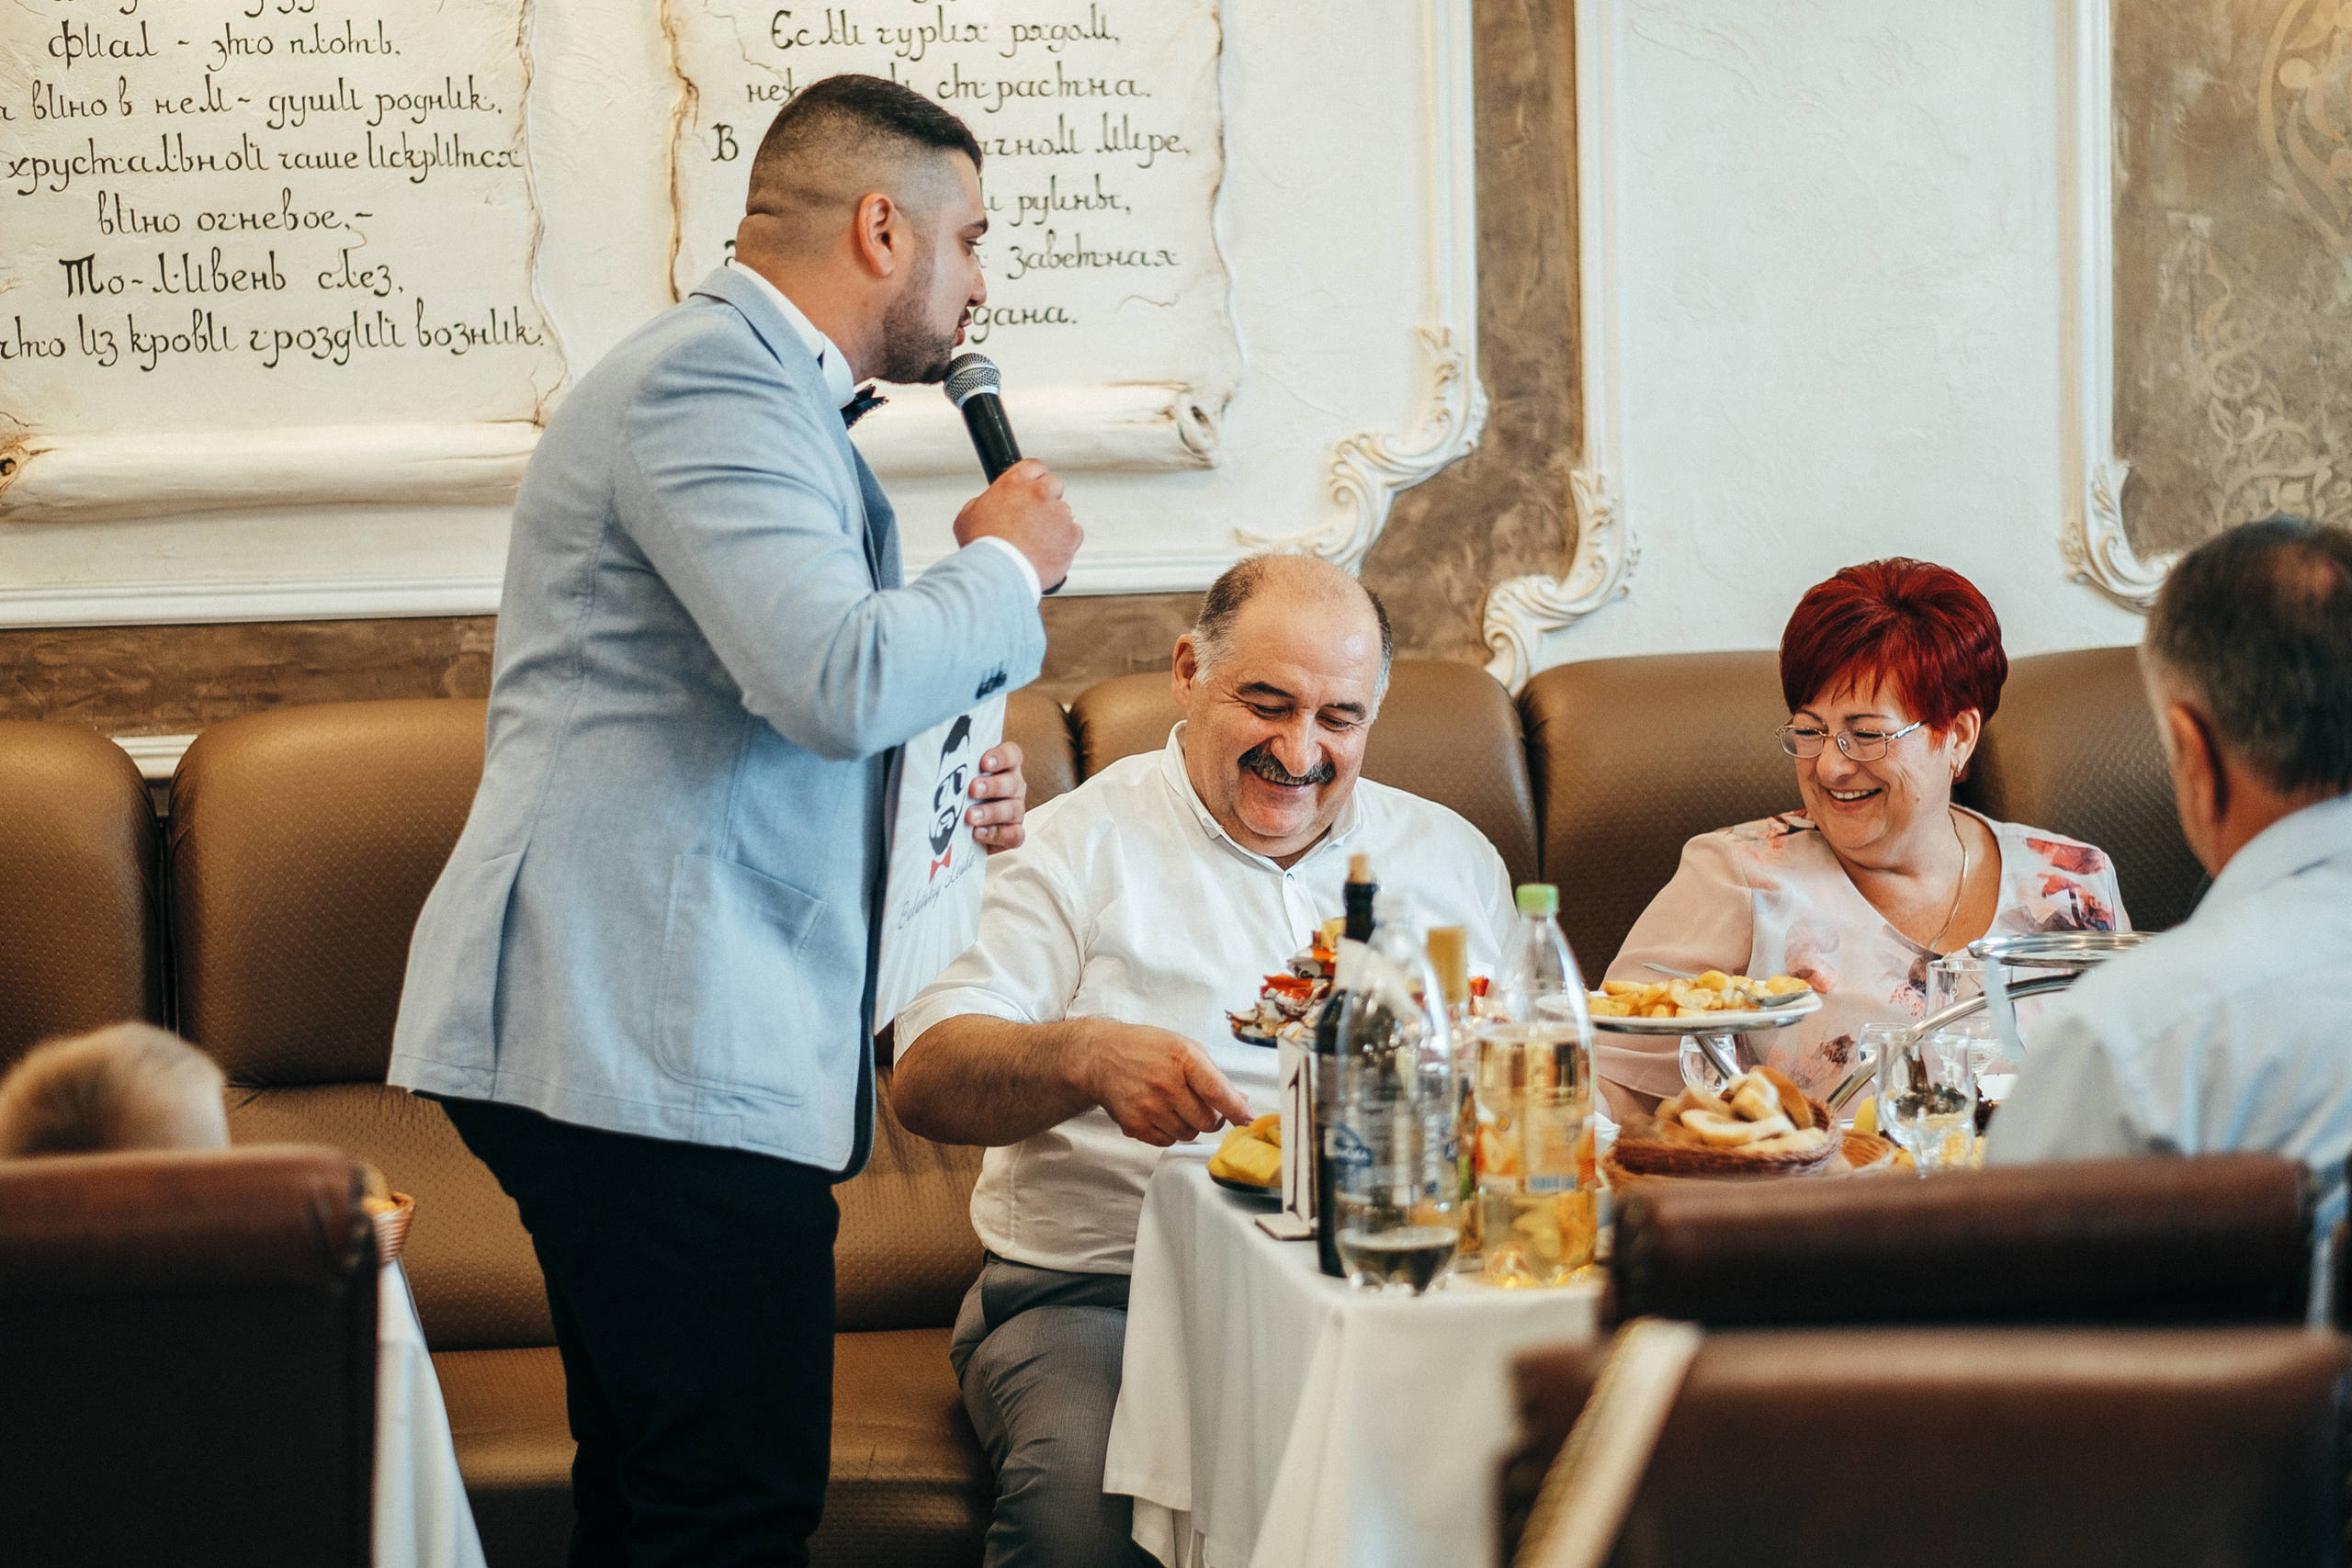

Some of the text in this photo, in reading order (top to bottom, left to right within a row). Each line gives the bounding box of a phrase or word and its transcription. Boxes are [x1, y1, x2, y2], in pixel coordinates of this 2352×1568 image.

[48, 18, 159, 71] фиал
[206, 22, 274, 72] это
[772, 9, 865, 49] Если
[876, 5, 988, 62] гурия
[32, 80, 107, 119] вино
[119, 75, 132, 116] в
[266, 77, 363, 130] души
[7, 130, 525, 196] хрустальной чаше искрится
[98, 190, 180, 235] вино
[1005, 228, 1181, 280] заветная
[78, 313, 118, 367] из
[127, 308, 239, 372] крови
[250, 310, 406, 368] гроздий
